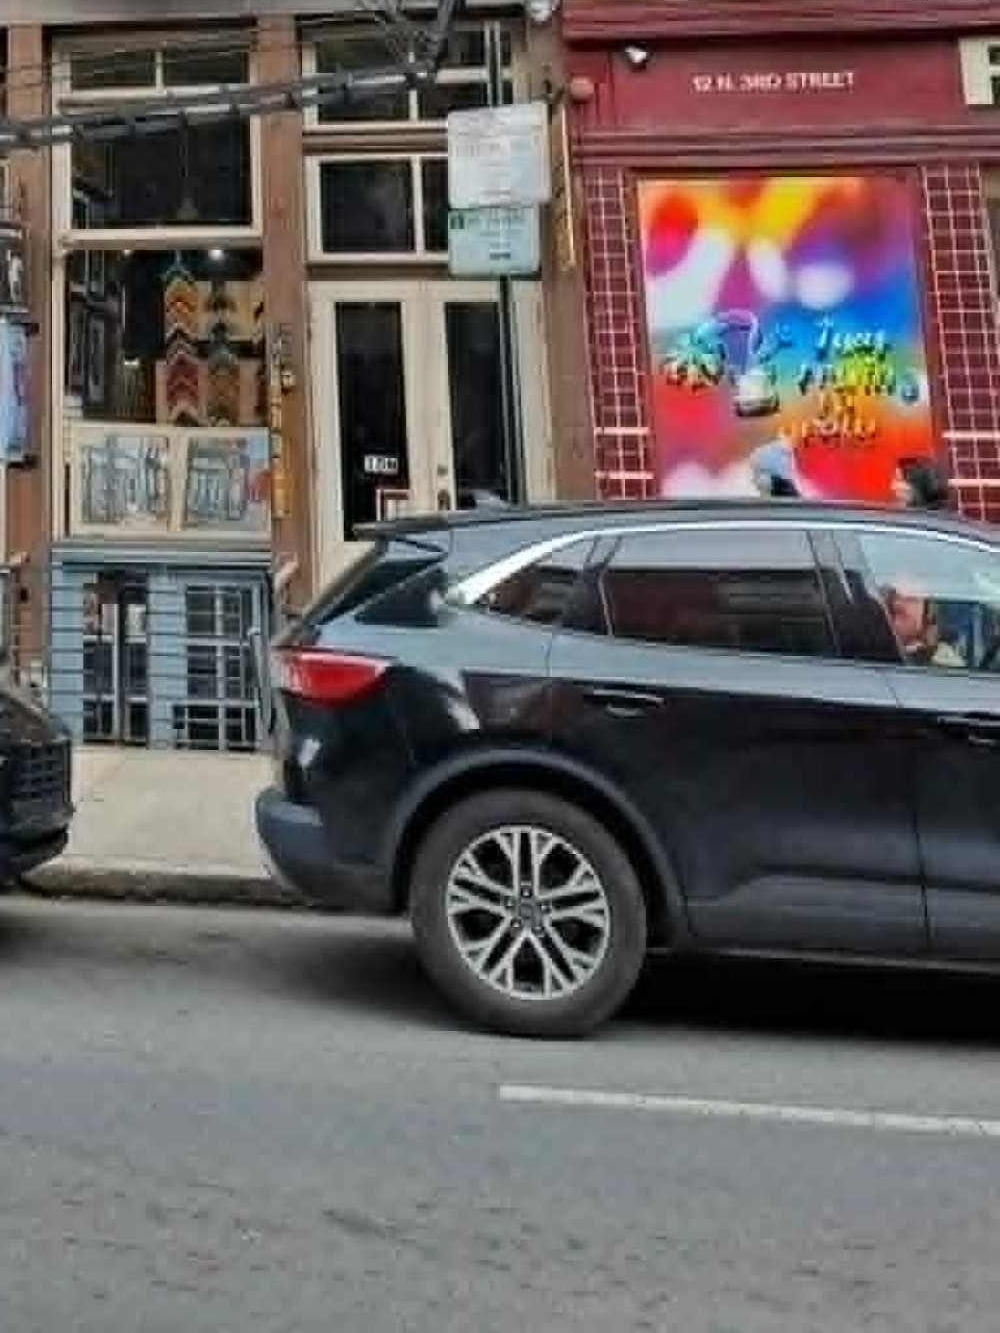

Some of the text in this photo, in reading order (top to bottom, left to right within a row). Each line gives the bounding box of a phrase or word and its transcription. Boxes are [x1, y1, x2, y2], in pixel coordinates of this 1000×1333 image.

[691, 73, 712, 92] 12
[739, 71, 782, 91] 3RD
[785, 69, 854, 91] STREET
